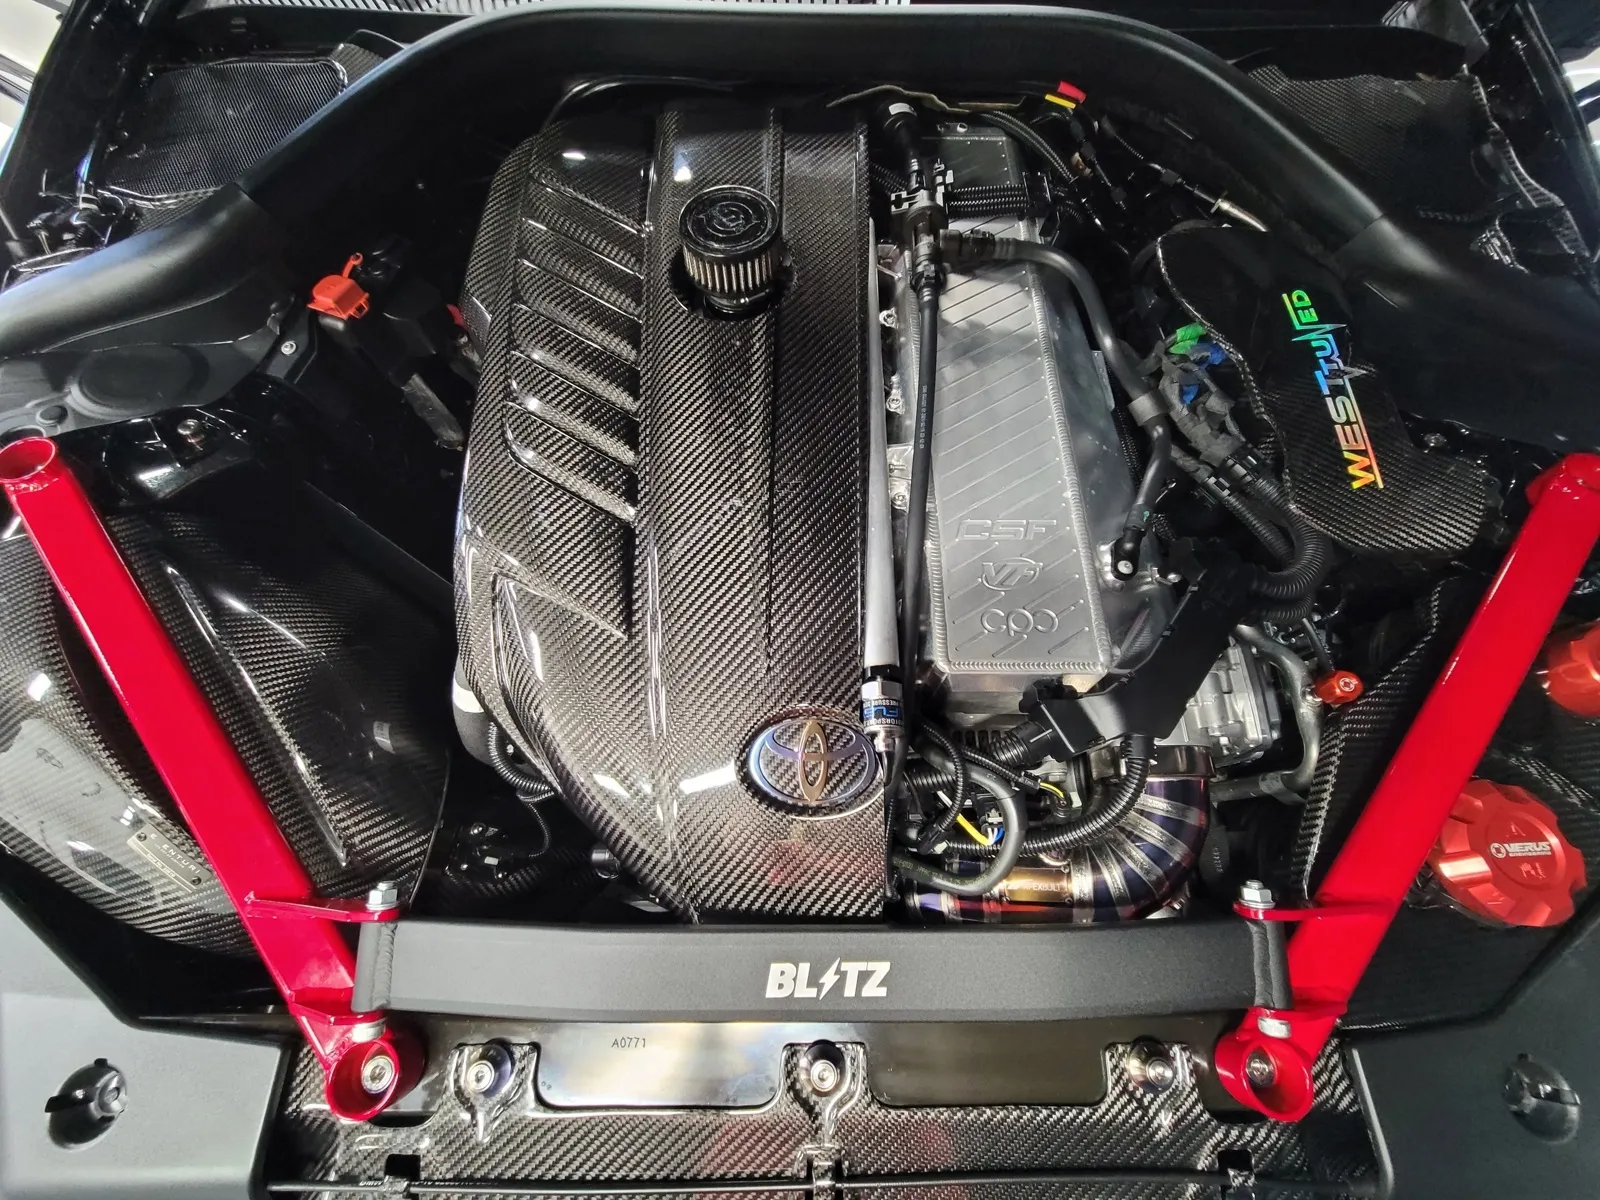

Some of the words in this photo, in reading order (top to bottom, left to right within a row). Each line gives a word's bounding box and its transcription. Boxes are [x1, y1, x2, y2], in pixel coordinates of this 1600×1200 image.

[956, 519, 1057, 541] CSF
[1503, 841, 1551, 852] VERUS
[765, 957, 891, 1000] BLITZ
[611, 1036, 646, 1048] A0771
